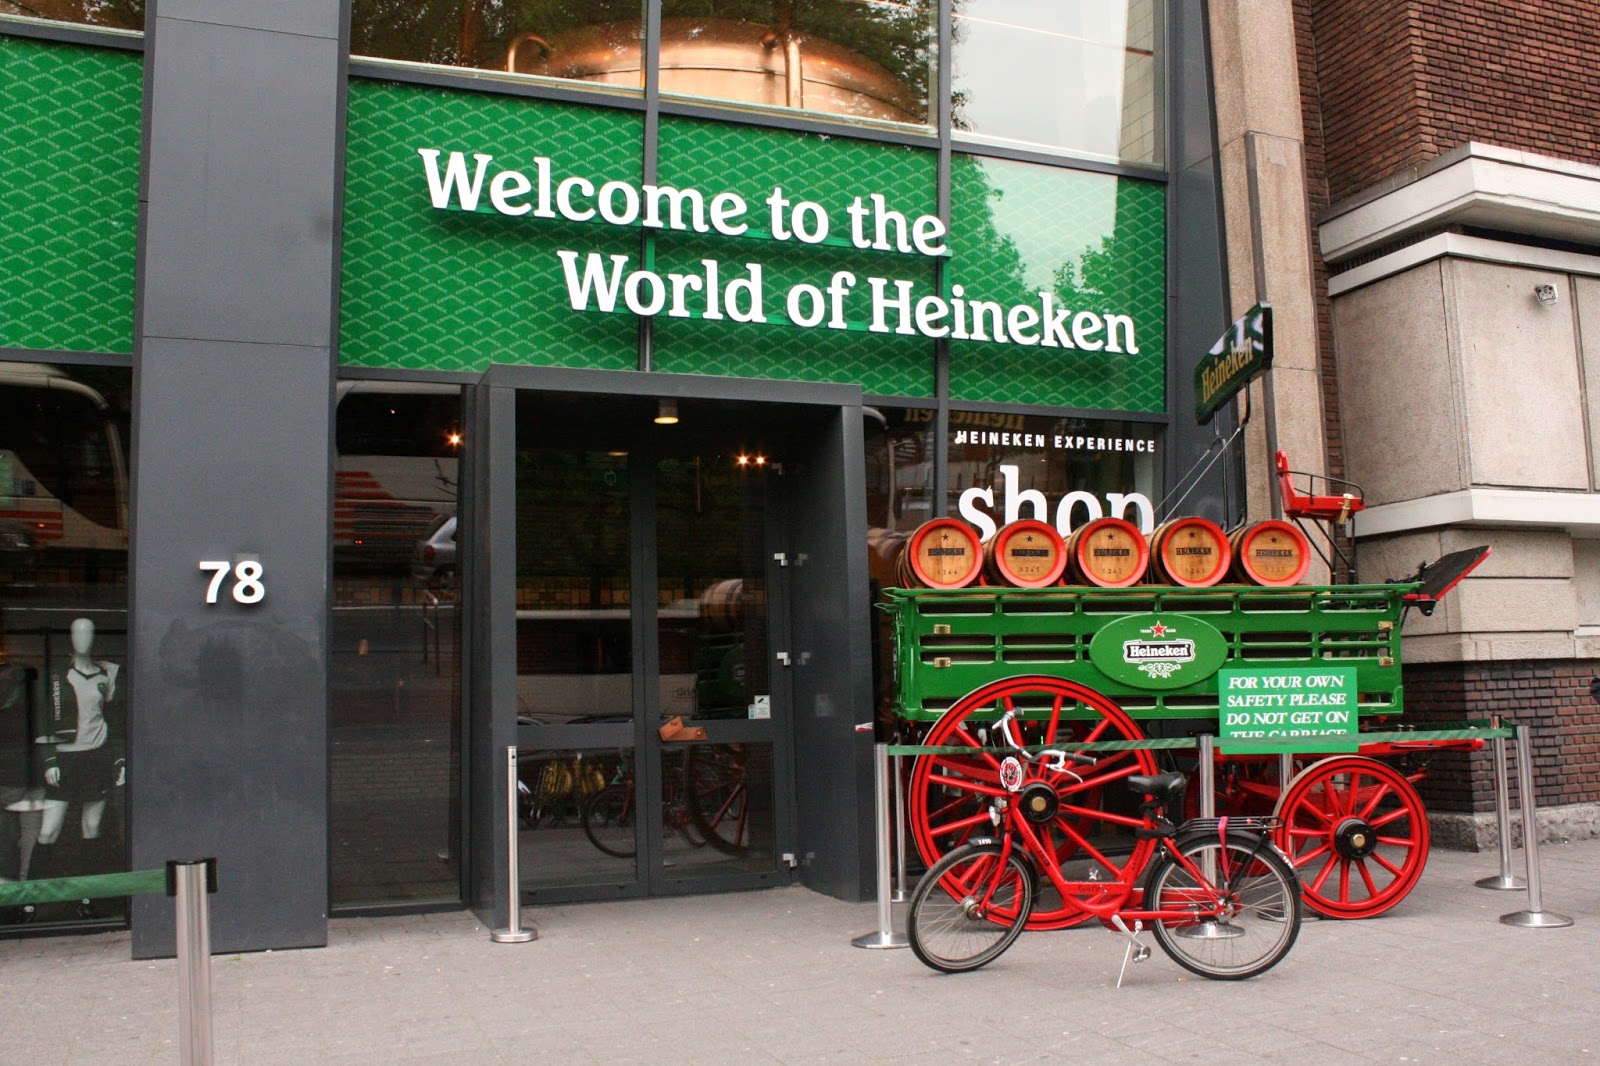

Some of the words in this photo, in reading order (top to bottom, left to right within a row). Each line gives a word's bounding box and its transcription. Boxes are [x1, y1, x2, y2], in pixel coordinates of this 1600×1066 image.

[417, 148, 748, 236] Welcome
[766, 187, 830, 244] to
[847, 193, 947, 256] the
[557, 250, 767, 323] World
[786, 271, 856, 330] of
[867, 277, 1140, 355] Heineken
[1201, 336, 1254, 404] Heineken
[955, 430, 1046, 448] HEINEKEN
[1054, 435, 1156, 453] EXPERIENCE
[199, 561, 265, 604] 78
[1129, 645, 1189, 658] Heineken
[1228, 676, 1258, 689] FOR
[1262, 676, 1302, 689] YOUR
[1305, 675, 1345, 688] OWN
[1226, 694, 1287, 708] SAFETY
[1289, 693, 1347, 707] PLEASE
[1225, 713, 1251, 726] DO
[1253, 711, 1288, 725] NOT
[1290, 711, 1323, 724] GET
[1325, 711, 1350, 723] ON
